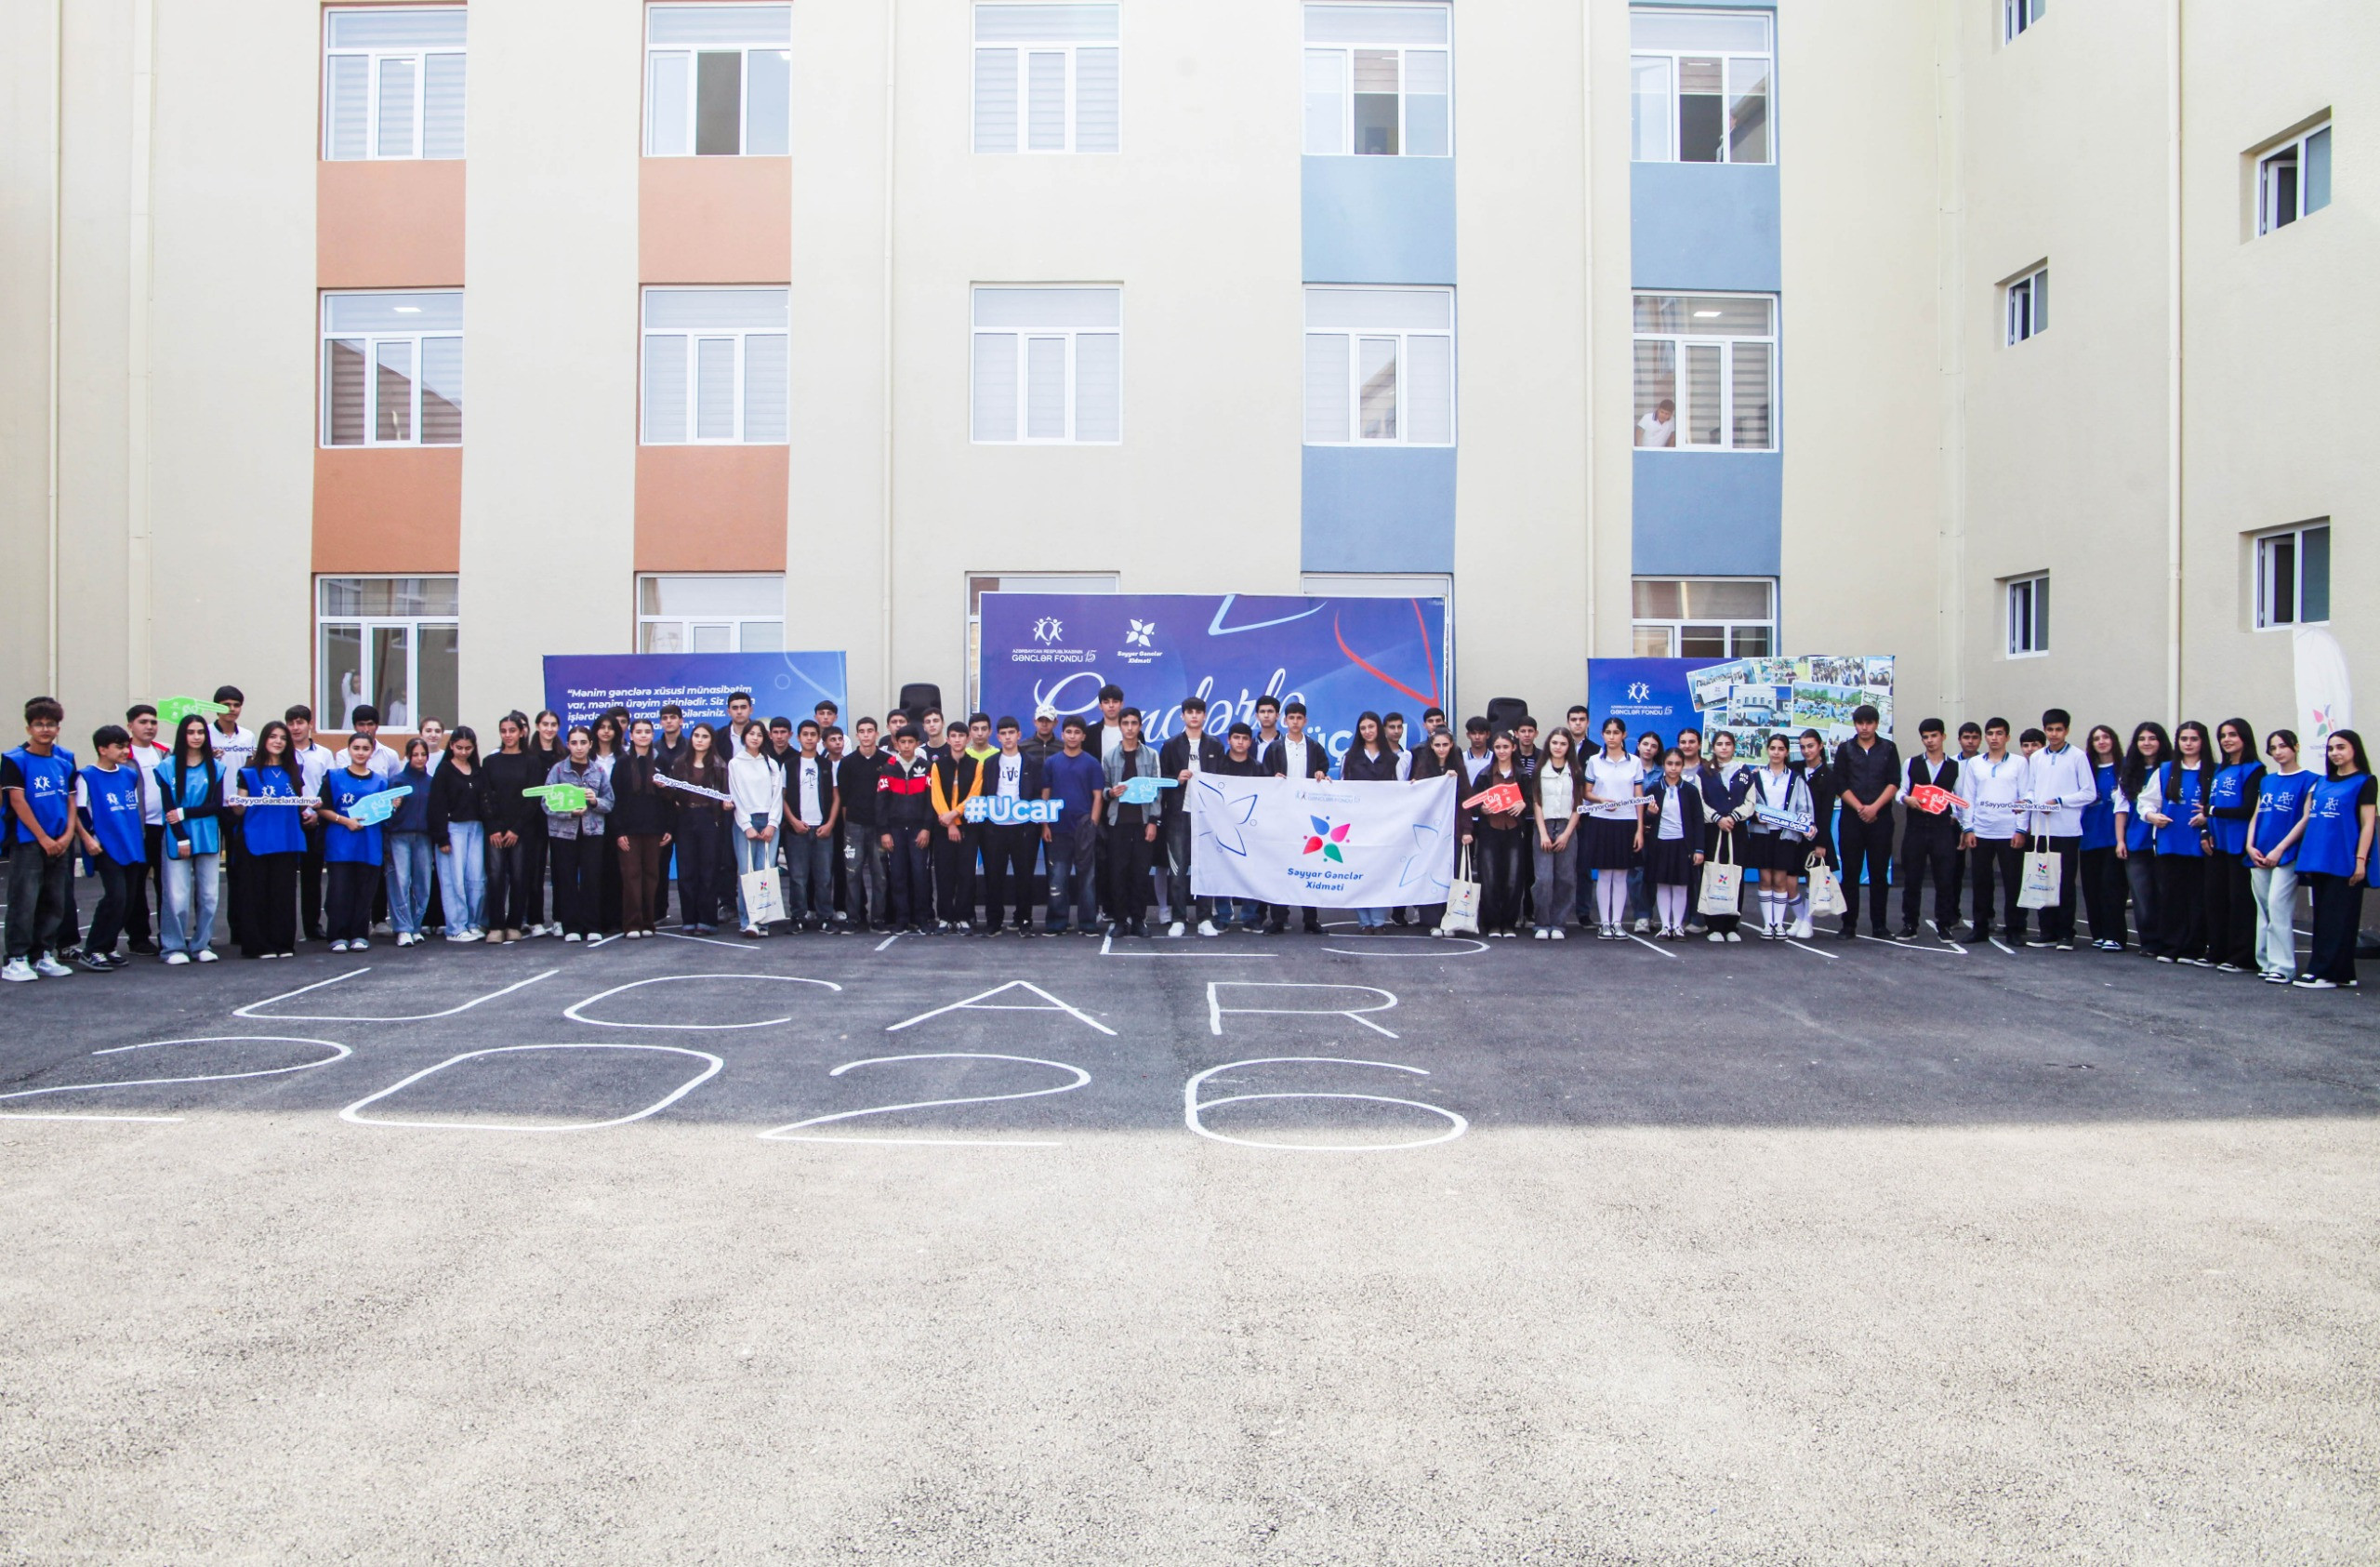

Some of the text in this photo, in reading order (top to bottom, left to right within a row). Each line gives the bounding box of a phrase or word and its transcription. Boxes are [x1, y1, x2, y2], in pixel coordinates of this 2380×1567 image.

[1012, 654, 1052, 662] GƏNCLƏR
[608, 687, 652, 698] gənclərə
[654, 685, 685, 696] xüsusi
[567, 701, 586, 710] var,
[588, 699, 624, 709] mənim
[626, 697, 660, 710] ürəyim
[662, 697, 707, 707] sizinlədir.
[709, 697, 724, 706] Siz
[964, 797, 1063, 823] #Ucar
[1288, 868, 1364, 880] Səyyar Gənclər
[1305, 881, 1344, 891] Xidməti
[0, 1035, 1470, 1149] 2026
